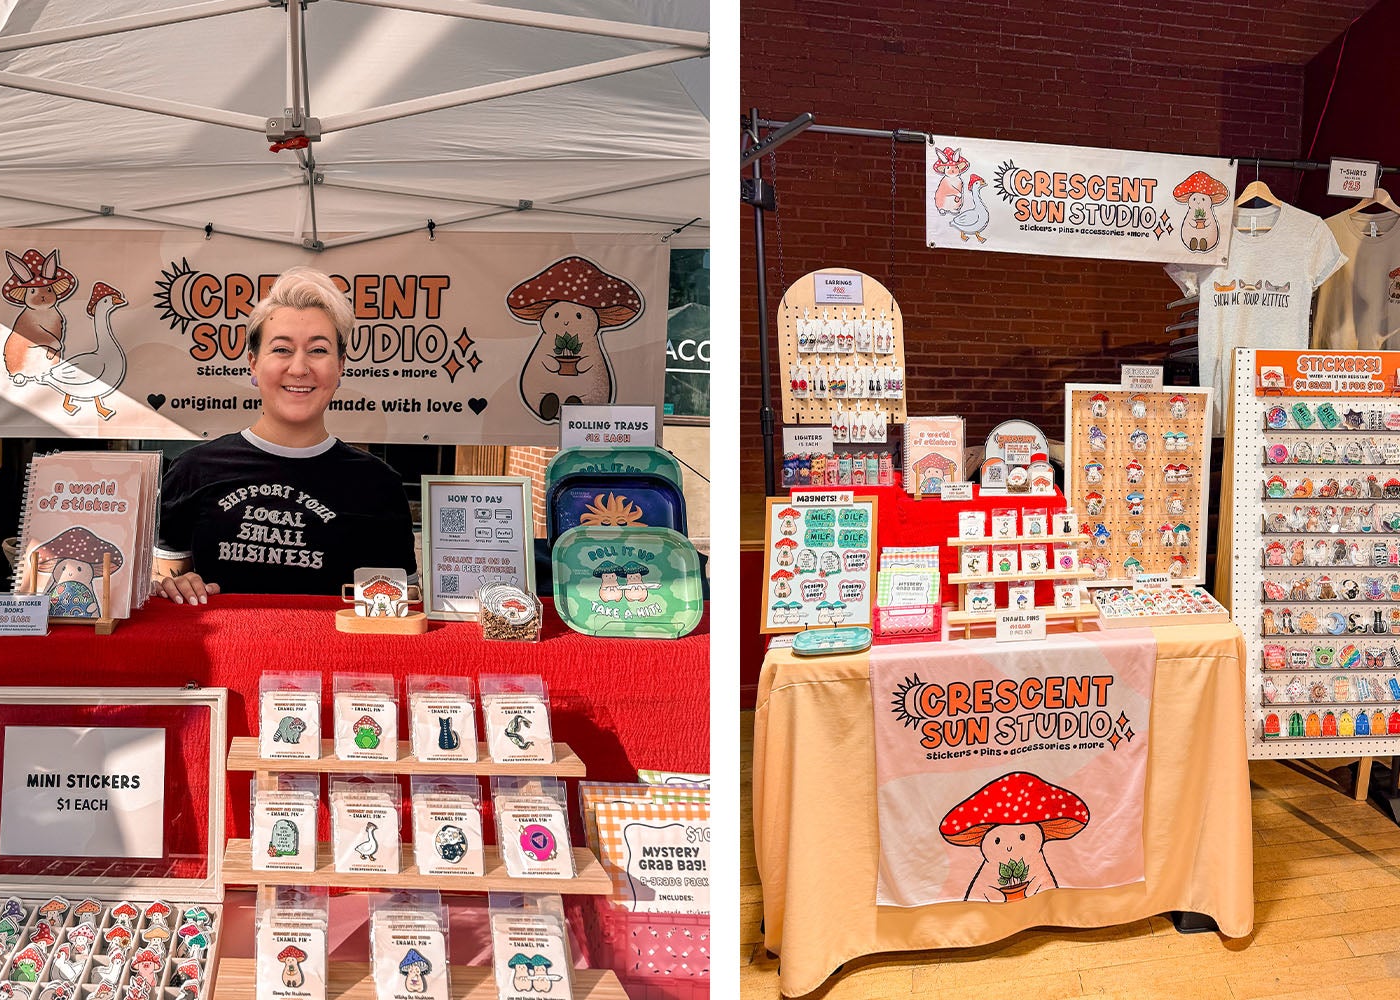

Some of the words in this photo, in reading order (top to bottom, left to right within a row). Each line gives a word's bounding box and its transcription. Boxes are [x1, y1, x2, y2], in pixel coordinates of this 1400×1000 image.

[1340, 168, 1367, 177] T-SHIRTS
[1014, 169, 1158, 204] CRESCENT
[1343, 180, 1361, 191] $25
[1014, 199, 1065, 224] SUN
[1068, 202, 1158, 229] STUDIO
[1019, 223, 1053, 232] stickers
[1058, 226, 1075, 234] pins
[1080, 227, 1125, 237] accessories
[1130, 230, 1151, 238] more
[1213, 293, 1230, 308] SHOW
[1231, 293, 1241, 306] ME
[1243, 292, 1260, 306] YOUR
[1261, 292, 1290, 308] KITTIES
[190, 322, 247, 361] SU
[346, 323, 448, 363] UDIO
[341, 366, 390, 378] ssories
[401, 368, 438, 378] more
[1299, 357, 1380, 373] STICKERS!
[171, 396, 237, 413] original
[329, 398, 376, 412] made
[382, 398, 422, 413] with
[426, 398, 463, 413] love
[568, 420, 611, 430] ROLLING
[614, 421, 649, 431] TRAYS
[603, 433, 631, 443] EACH
[54, 482, 64, 493] a
[70, 481, 116, 496] world
[39, 497, 59, 509] of
[60, 497, 127, 512] stickers
[218, 483, 294, 512] SUPPORT
[448, 495, 468, 503] HOW
[471, 495, 483, 503] TO
[485, 495, 502, 504] PAY
[796, 495, 837, 503] MAGNETS!
[296, 491, 337, 524] YOUR
[242, 505, 307, 528] LOCAL
[236, 522, 307, 547] SMALL
[218, 541, 325, 570] BUSINESS
[588, 545, 618, 561] ROLL
[622, 545, 636, 557] IT
[637, 548, 655, 561] UP
[462, 564, 480, 573] FREE
[591, 600, 620, 618] TAKE
[625, 610, 633, 618] A
[637, 602, 663, 618] HIT!
[920, 676, 1113, 718] CRESCENT
[919, 717, 989, 750] SUN
[994, 710, 1113, 746] STUDIO
[926, 749, 972, 760] stickers
[980, 748, 1002, 757] pins
[1010, 742, 1071, 756] accessories
[1078, 740, 1105, 750] more
[27, 774, 60, 789] MINI
[66, 774, 141, 789] STICKERS
[57, 797, 71, 812] $1
[74, 799, 108, 811] EACH
[642, 846, 700, 858] MYSTERY
[638, 859, 673, 871] GRAB
[677, 859, 707, 871] BAG!
